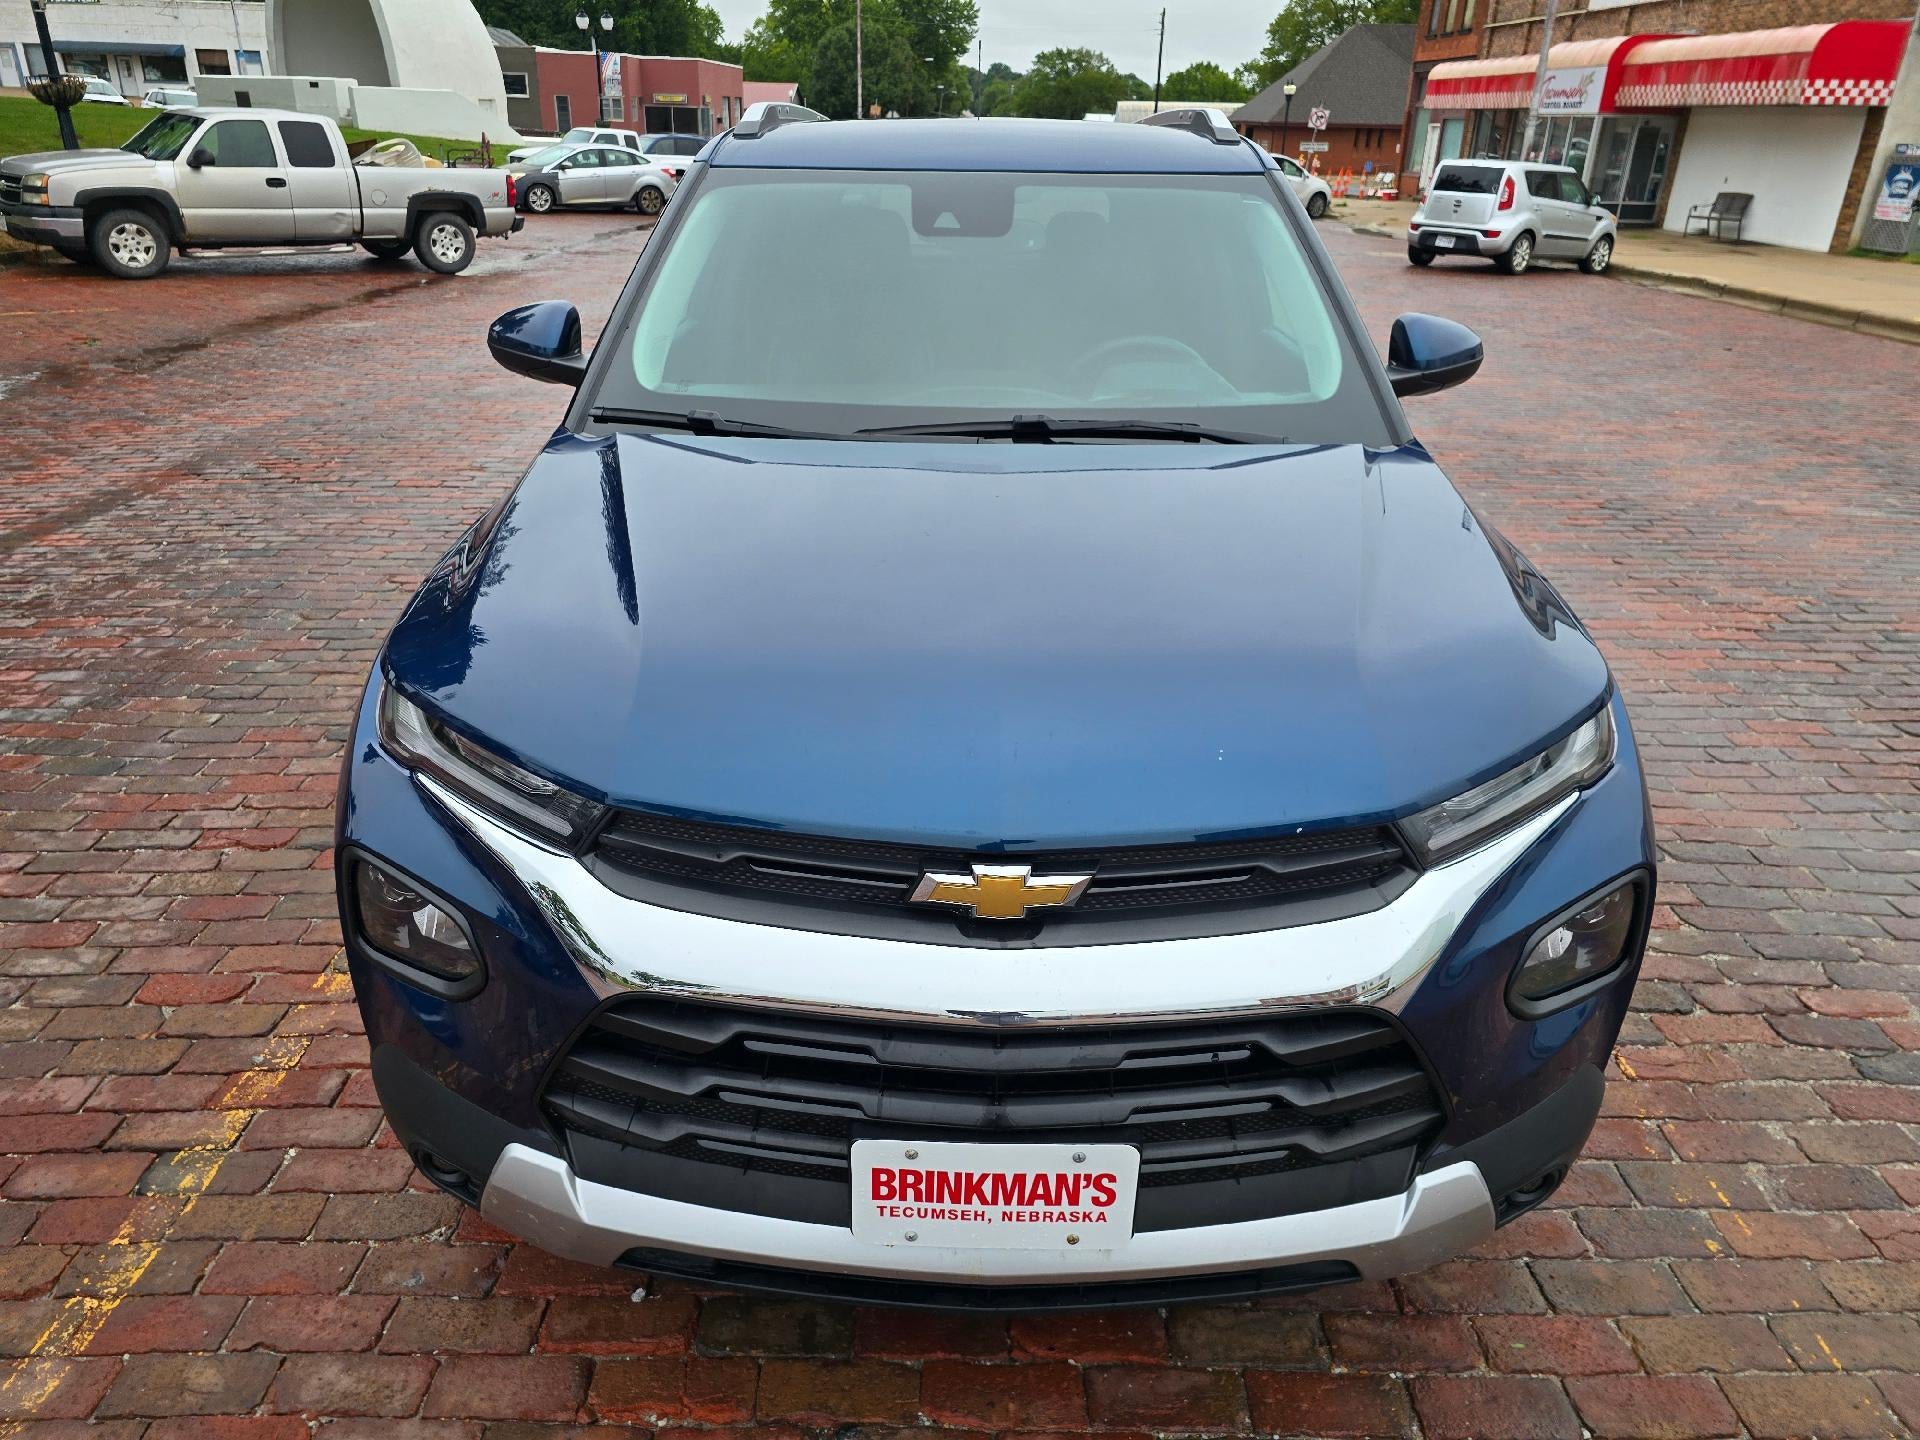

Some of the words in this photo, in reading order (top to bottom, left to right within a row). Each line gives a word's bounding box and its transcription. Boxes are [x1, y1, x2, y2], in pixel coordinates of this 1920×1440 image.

[871, 1168, 1117, 1207] BRINKMAN'S
[876, 1206, 992, 1224] TECUMSEH,
[1001, 1211, 1107, 1223] NEBRASKA
